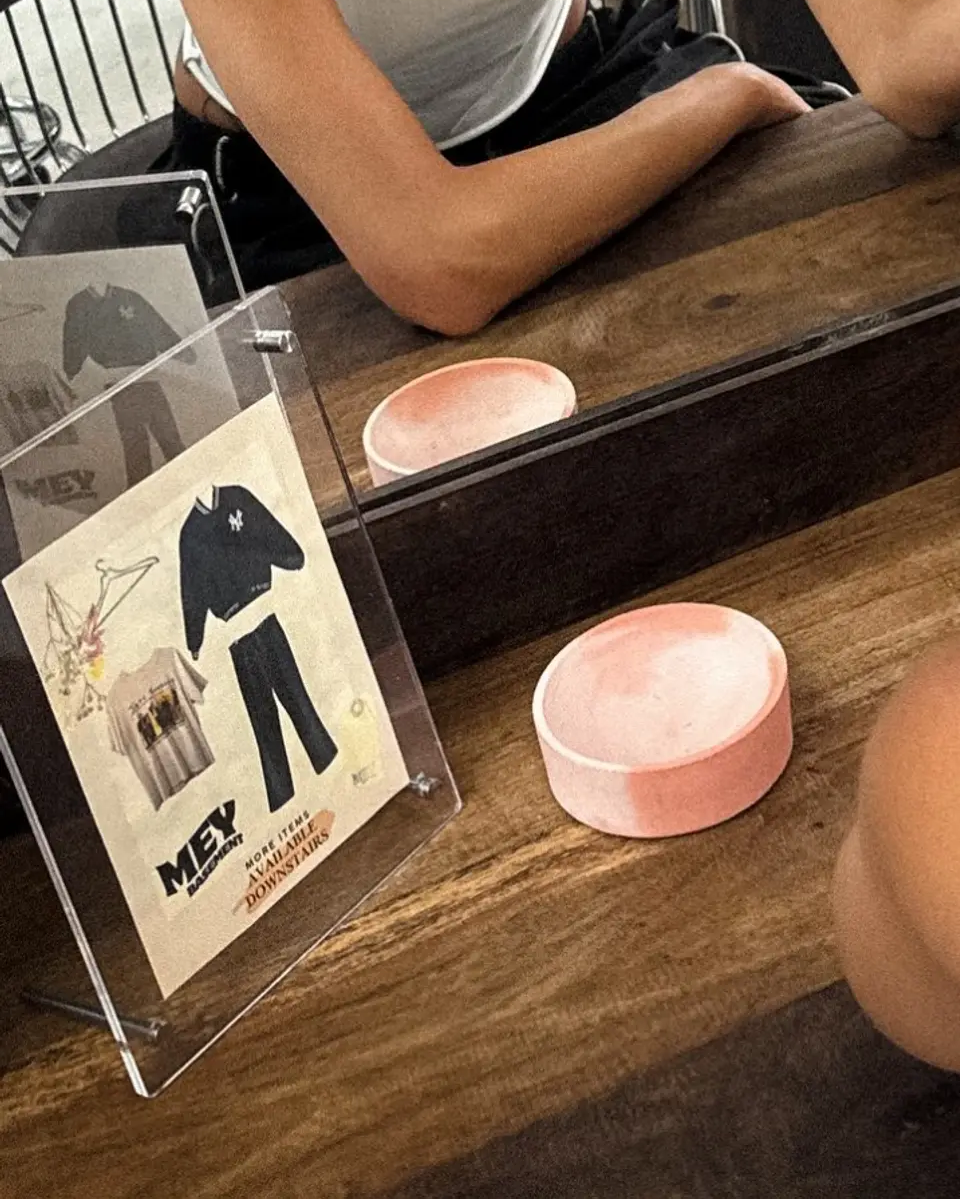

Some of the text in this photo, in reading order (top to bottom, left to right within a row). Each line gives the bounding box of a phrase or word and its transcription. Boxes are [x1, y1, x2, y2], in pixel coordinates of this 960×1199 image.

[156, 799, 236, 897] MEY
[186, 833, 243, 897] BASEMENT
[245, 810, 309, 869] MORE ITEMS
[245, 828, 329, 909] DOWNSTAIRS
[248, 819, 318, 888] AVAILABLE
